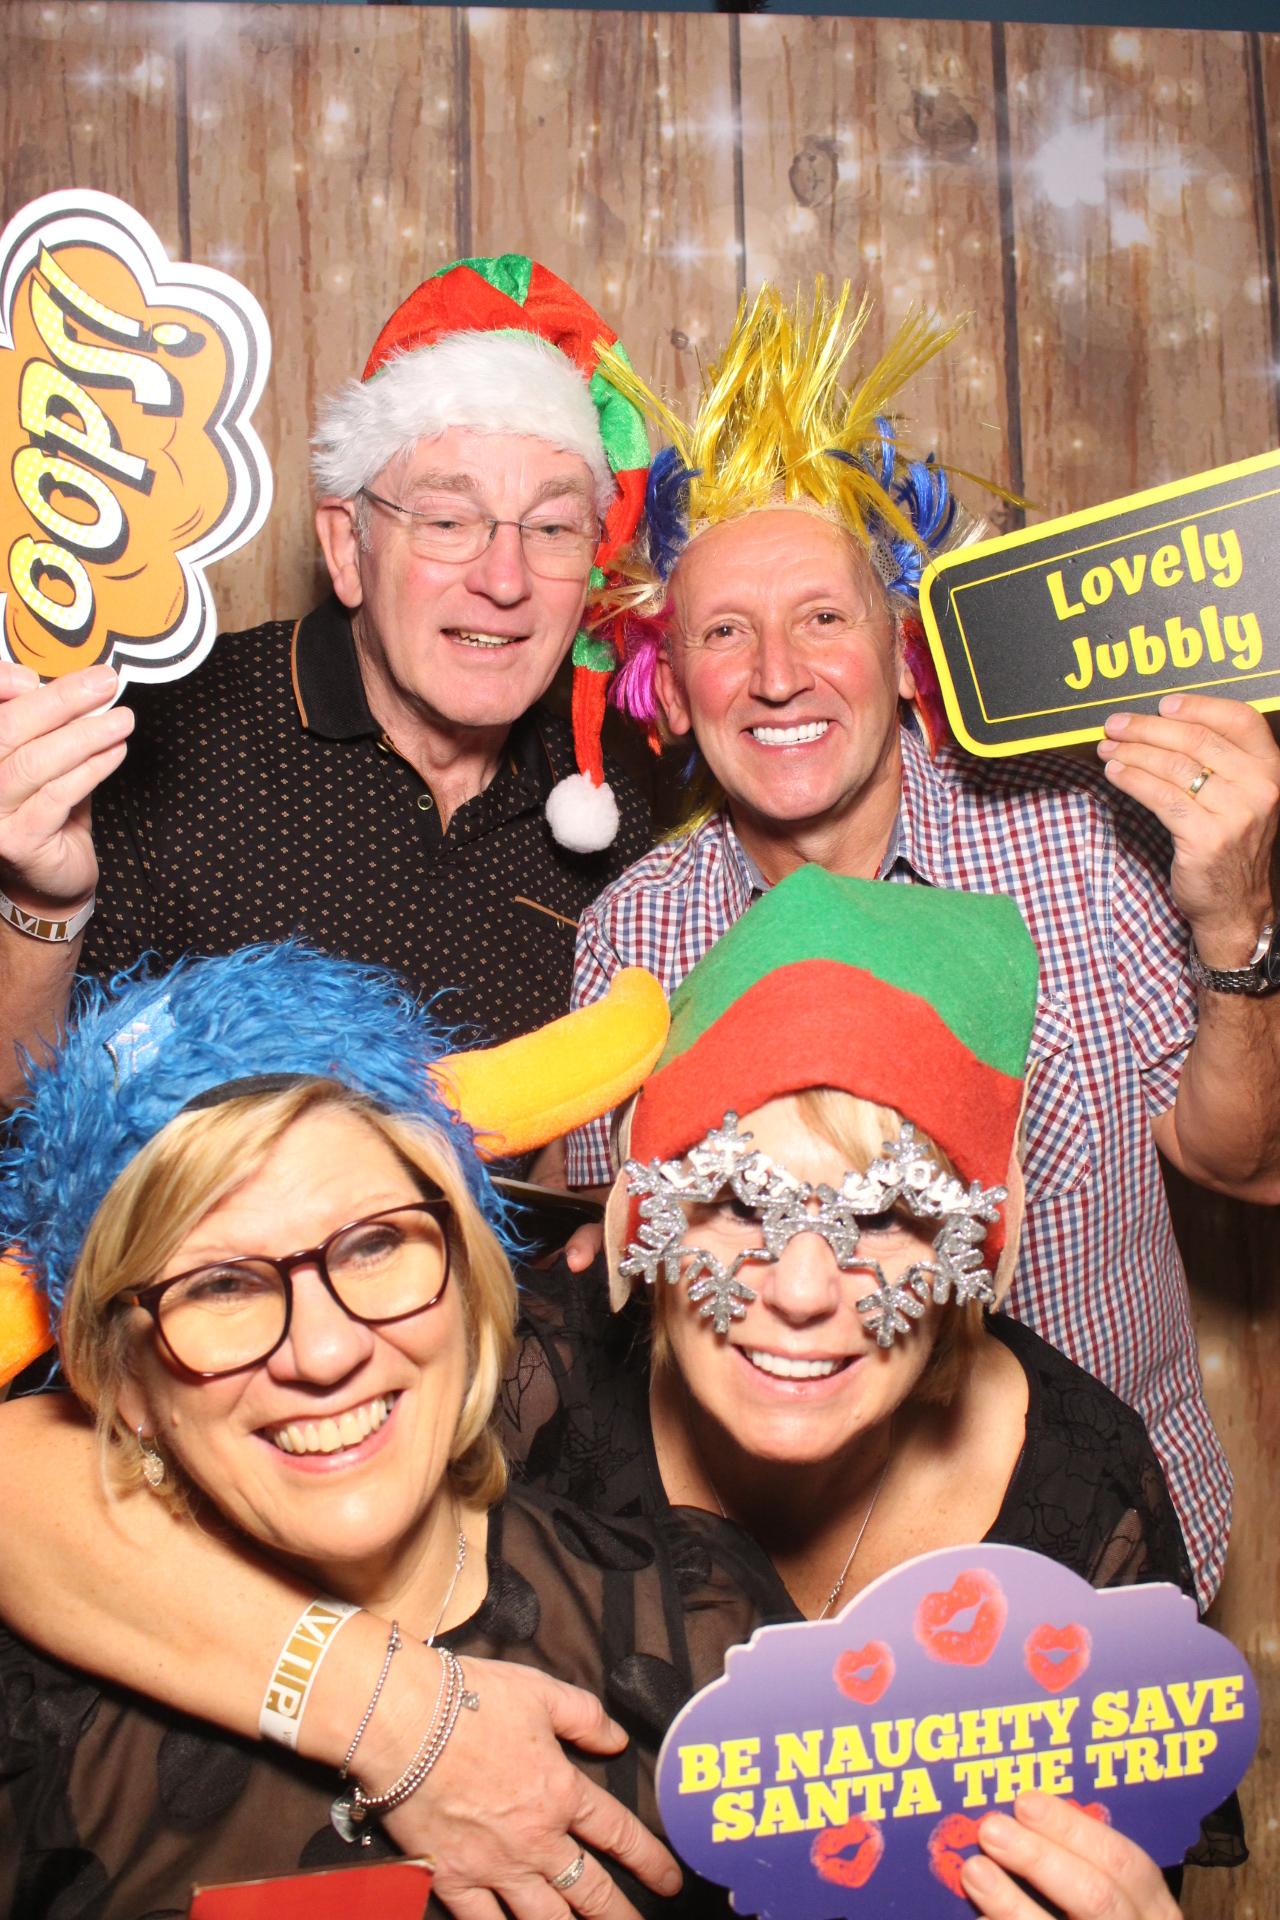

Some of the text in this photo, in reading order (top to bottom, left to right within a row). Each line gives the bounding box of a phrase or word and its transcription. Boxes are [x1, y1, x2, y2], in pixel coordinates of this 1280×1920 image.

[1046, 525, 1243, 620] Lovely
[1064, 605, 1263, 690] Jubbly
[14, 907, 59, 940] VI
[270, 1614, 339, 1718] VIP
[678, 1675, 1244, 1794] BE NAUGHTY SAVE
[712, 1729, 1218, 1843] SANTA THE TRIP
